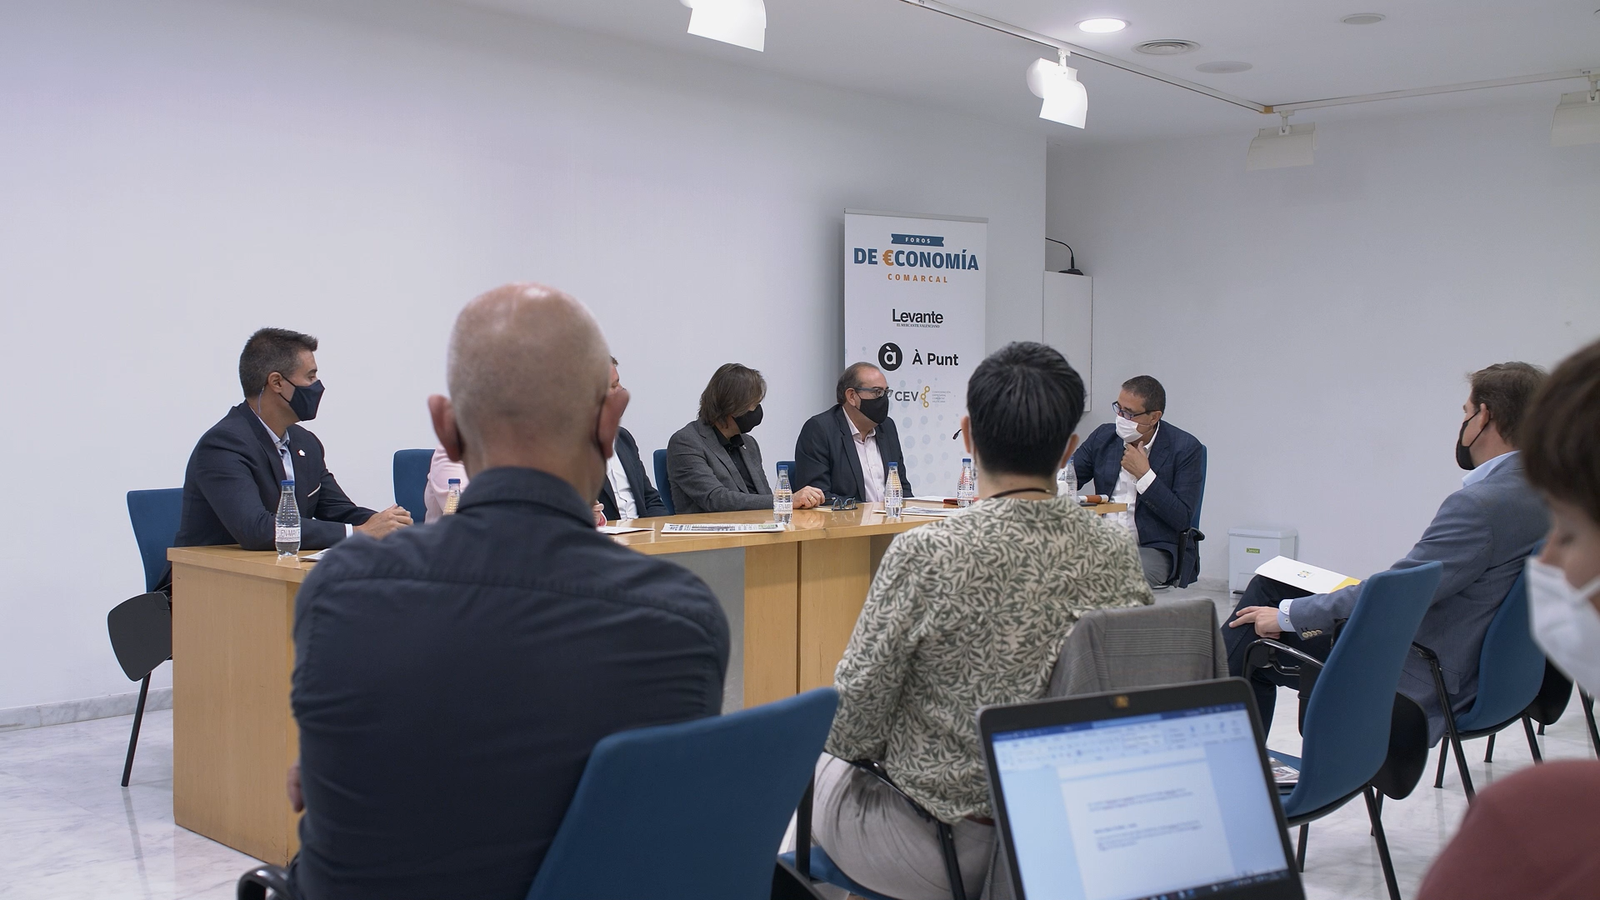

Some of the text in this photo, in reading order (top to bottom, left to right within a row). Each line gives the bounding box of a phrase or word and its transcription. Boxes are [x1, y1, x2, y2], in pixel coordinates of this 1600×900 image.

[853, 248, 878, 265] DE
[887, 273, 948, 283] COMARCAL
[892, 308, 944, 324] Levante
[912, 349, 959, 366] À Punt
[894, 391, 919, 402] CEV
